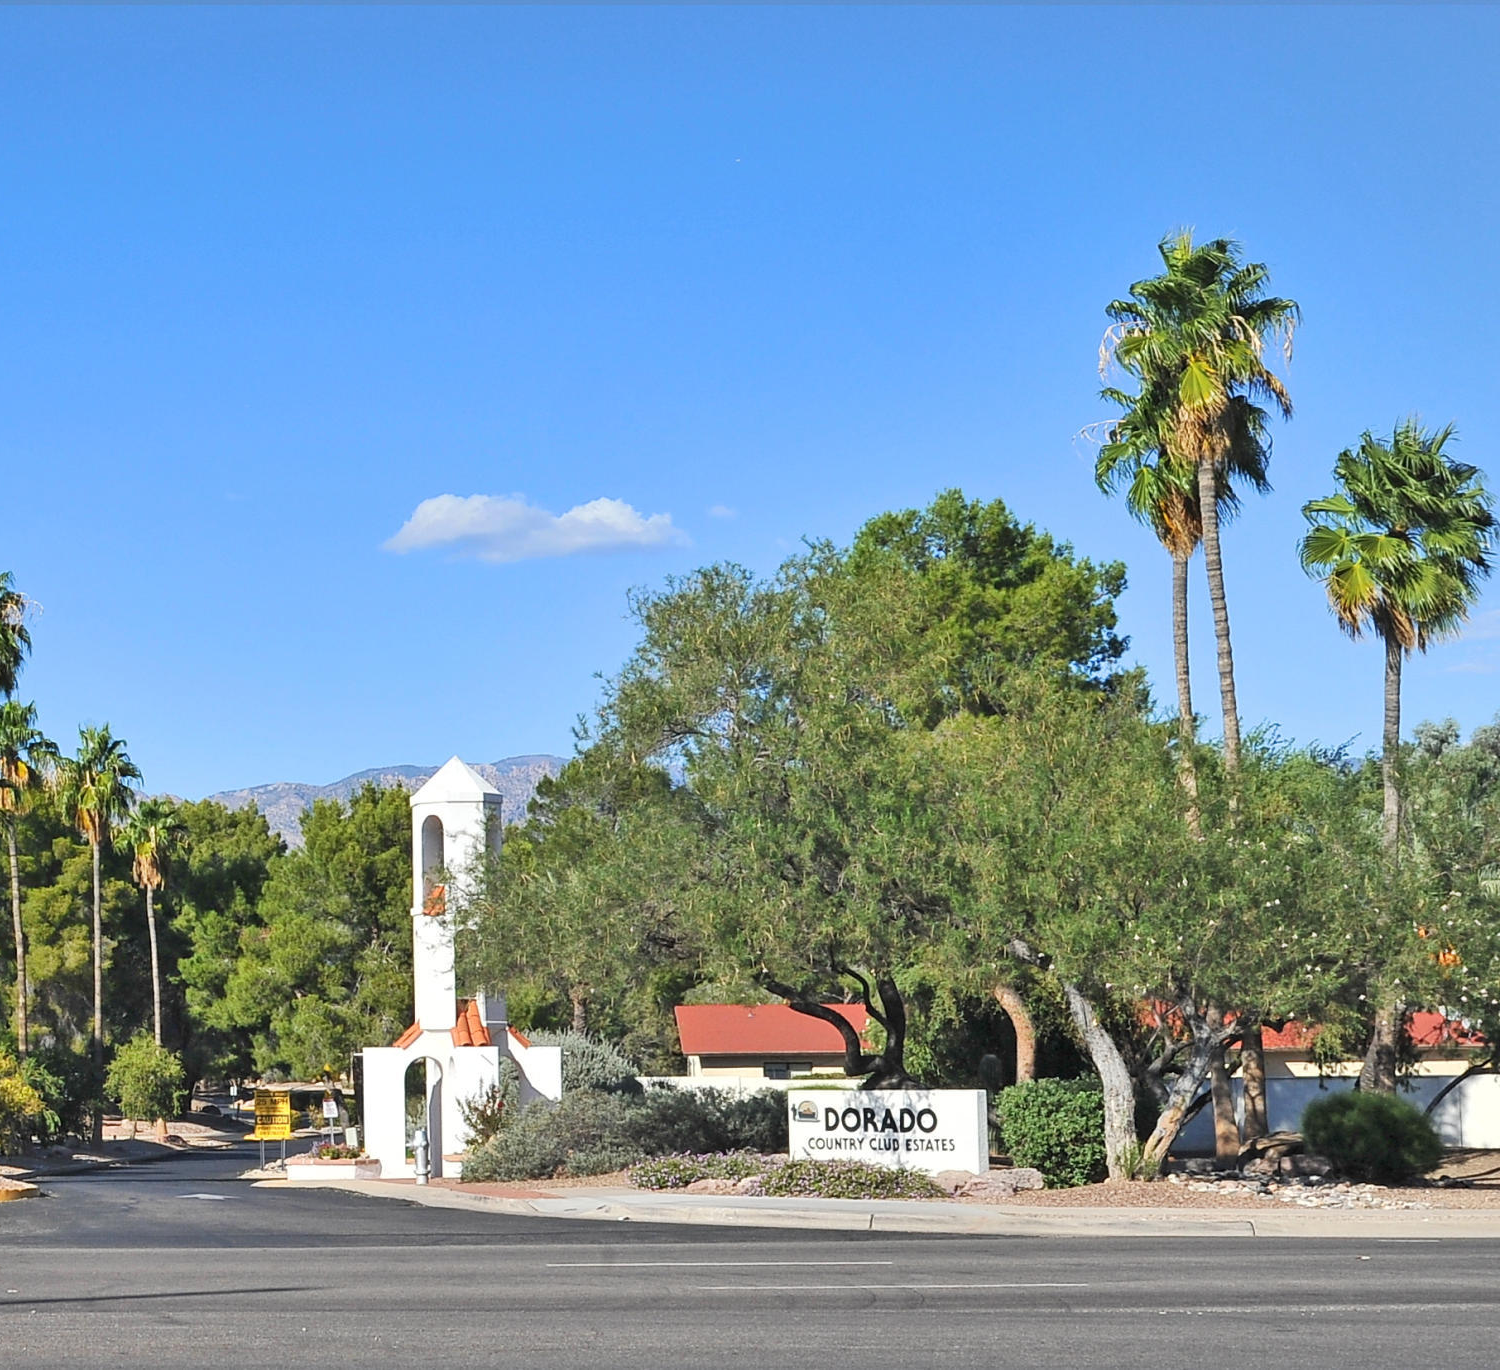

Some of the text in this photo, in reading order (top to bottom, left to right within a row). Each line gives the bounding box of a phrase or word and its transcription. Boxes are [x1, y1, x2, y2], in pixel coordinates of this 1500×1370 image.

[256, 1116, 288, 1124] CAUTION
[824, 1107, 938, 1133] DORADO
[808, 1137, 955, 1152] COUNTRY CLUB ESTATES
